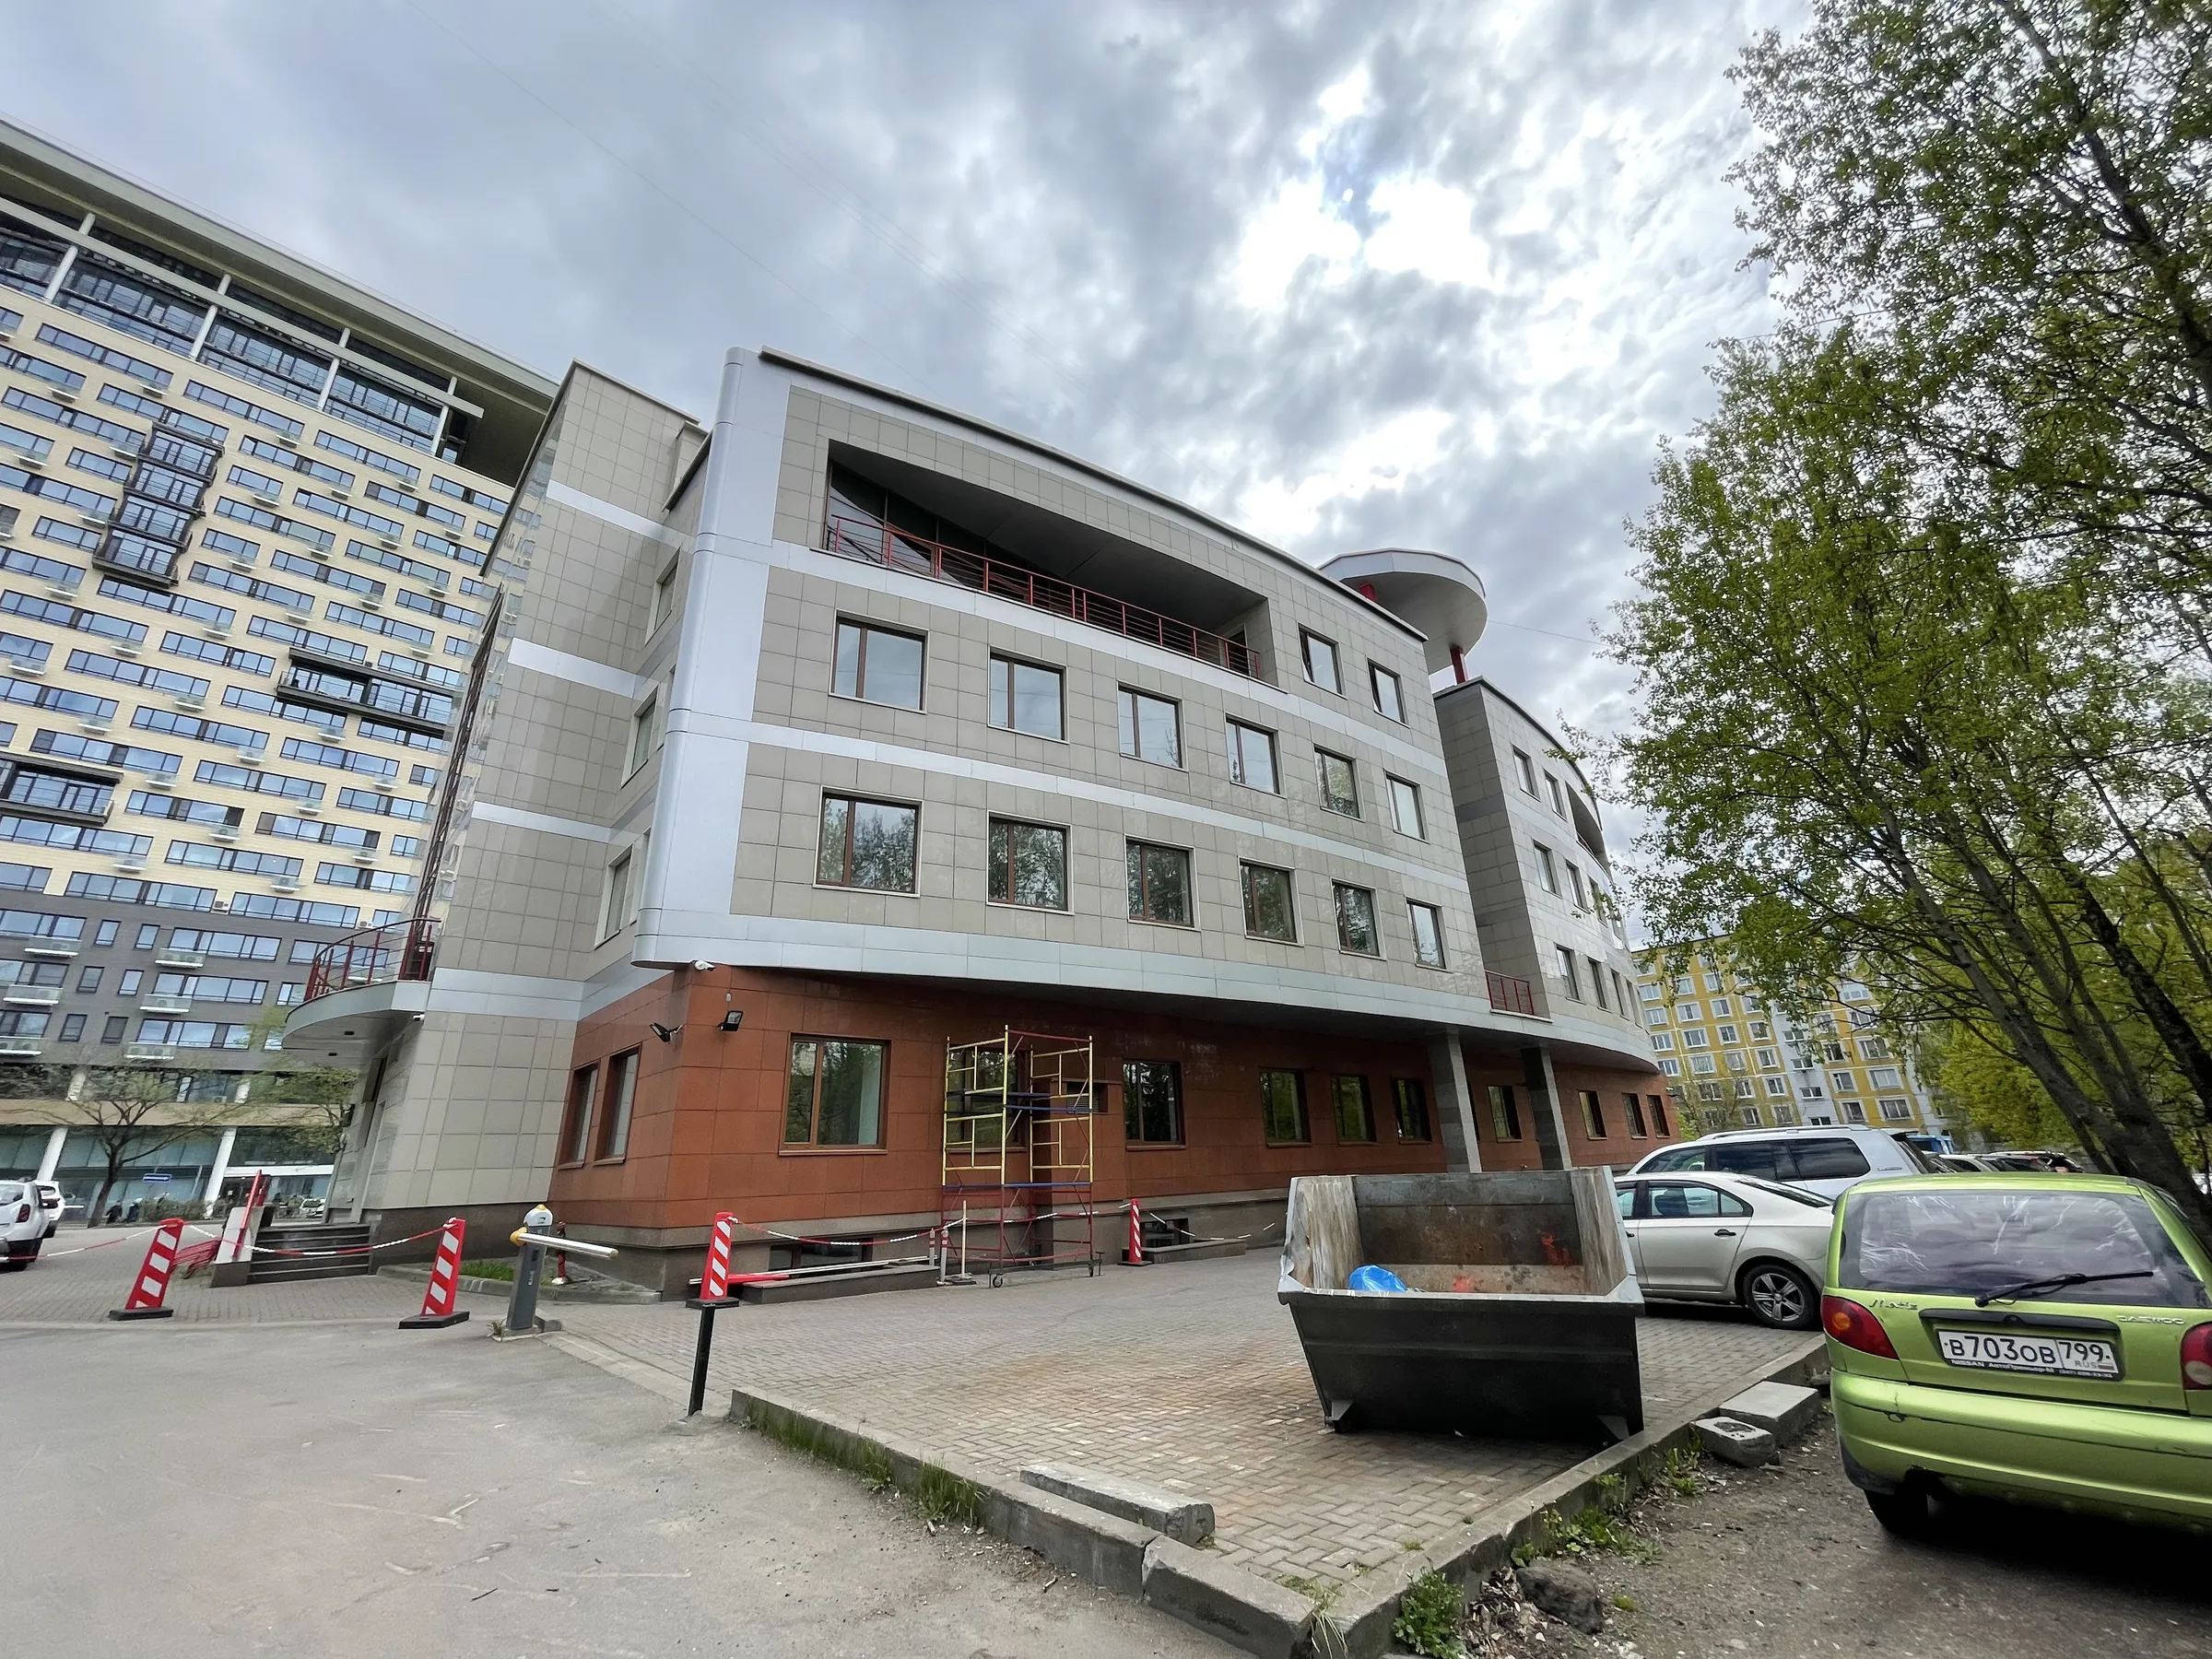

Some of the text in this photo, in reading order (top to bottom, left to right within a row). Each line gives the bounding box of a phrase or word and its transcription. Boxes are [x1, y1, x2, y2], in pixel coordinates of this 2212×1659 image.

[1869, 1298, 1918, 1310] Matiz
[2116, 1315, 2185, 1325] DAEWOO
[1948, 1335, 2103, 1364] В703ОВ 799
[2074, 1360, 2098, 1370] RUS
